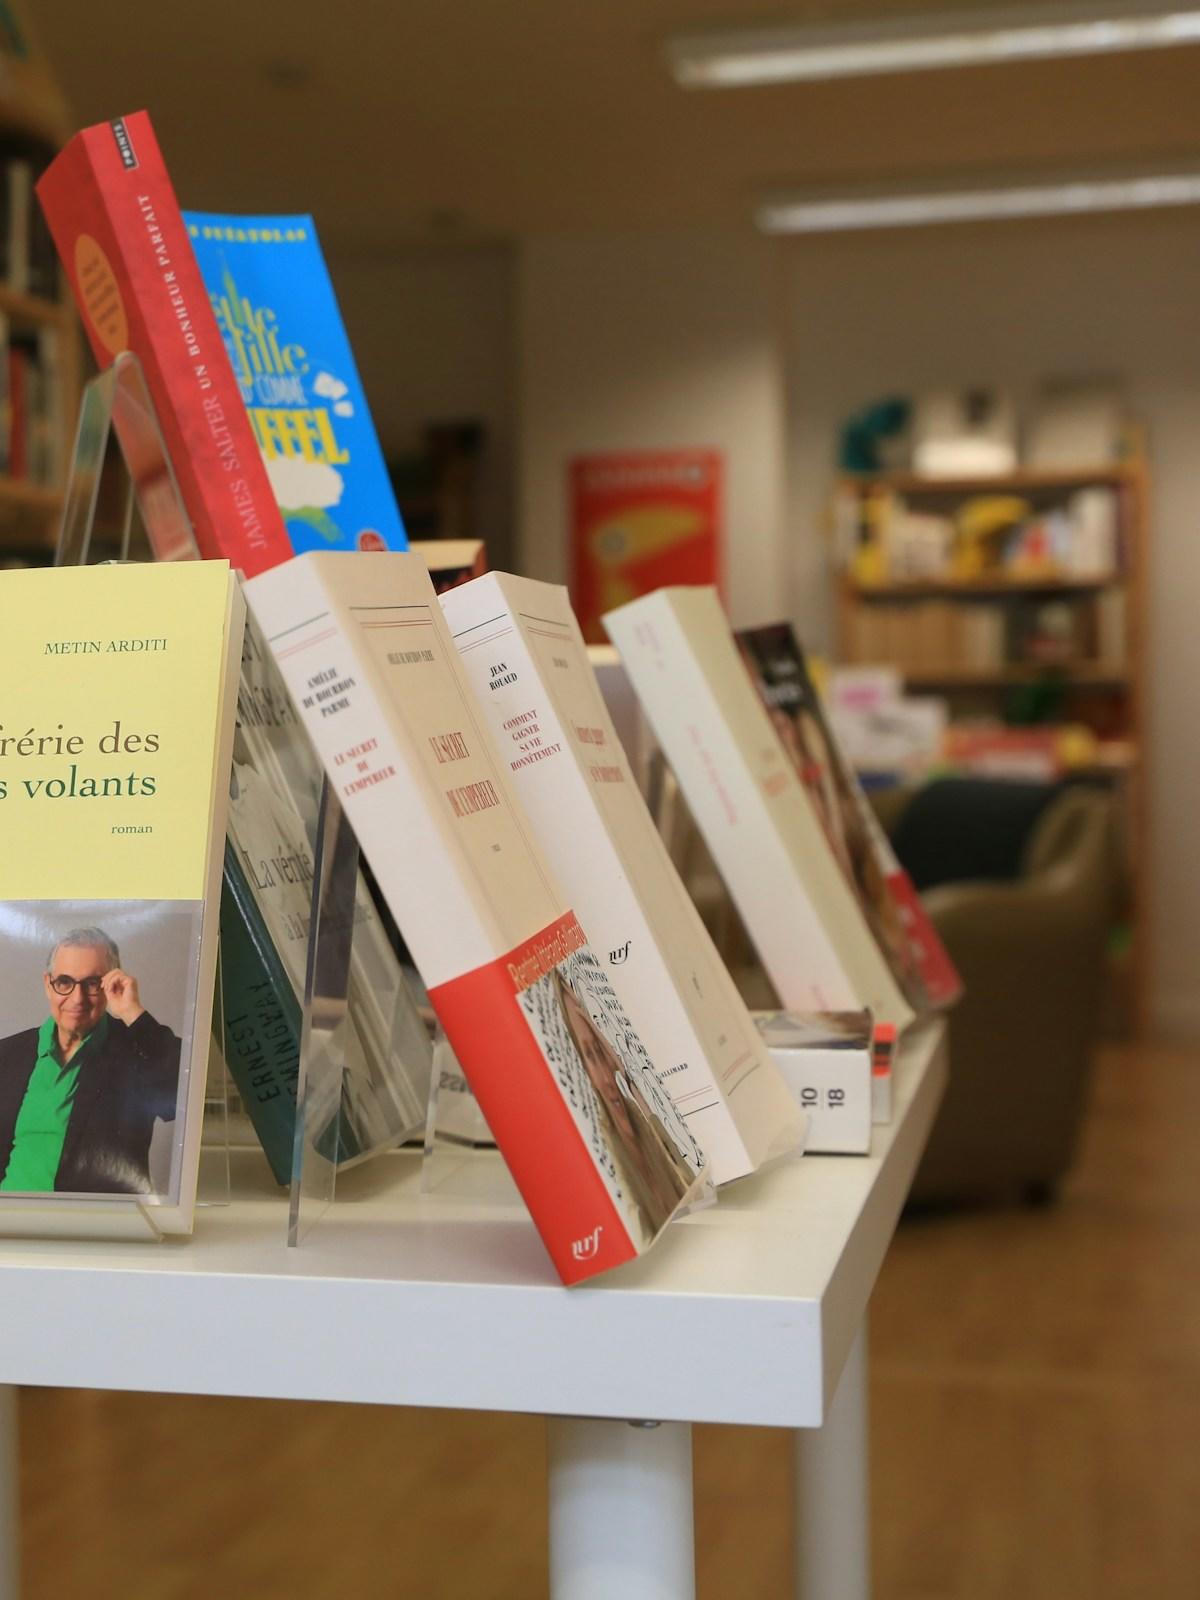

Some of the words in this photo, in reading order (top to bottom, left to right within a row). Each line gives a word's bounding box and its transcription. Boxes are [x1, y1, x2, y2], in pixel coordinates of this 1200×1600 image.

[138, 194, 171, 267] PARFAIT
[166, 270, 201, 356] BONHEUR
[193, 363, 212, 390] UN
[206, 396, 240, 472] SALTER
[248, 408, 349, 464] FFEL
[230, 475, 268, 549] JAMES
[44, 640, 102, 656] METIN
[106, 639, 168, 653] ARDITI
[489, 672, 519, 691] ROUAUD
[490, 662, 508, 677] JEAN
[320, 697, 352, 719] PARME
[503, 710, 538, 731] COMMENT
[98, 721, 160, 754] des
[511, 724, 541, 742] GAGNER
[529, 736, 543, 749] VIE
[510, 743, 563, 772] HONNÊTEMENT
[22, 764, 158, 799] volants
[111, 824, 154, 835] roman
[609, 940, 632, 965] nrf
[246, 981, 301, 1105] MINGWAY
[226, 1013, 281, 1103] ERNEST
[801, 1087, 819, 1109] 10
[828, 1088, 846, 1110] 18
[571, 1226, 604, 1261] nrf
